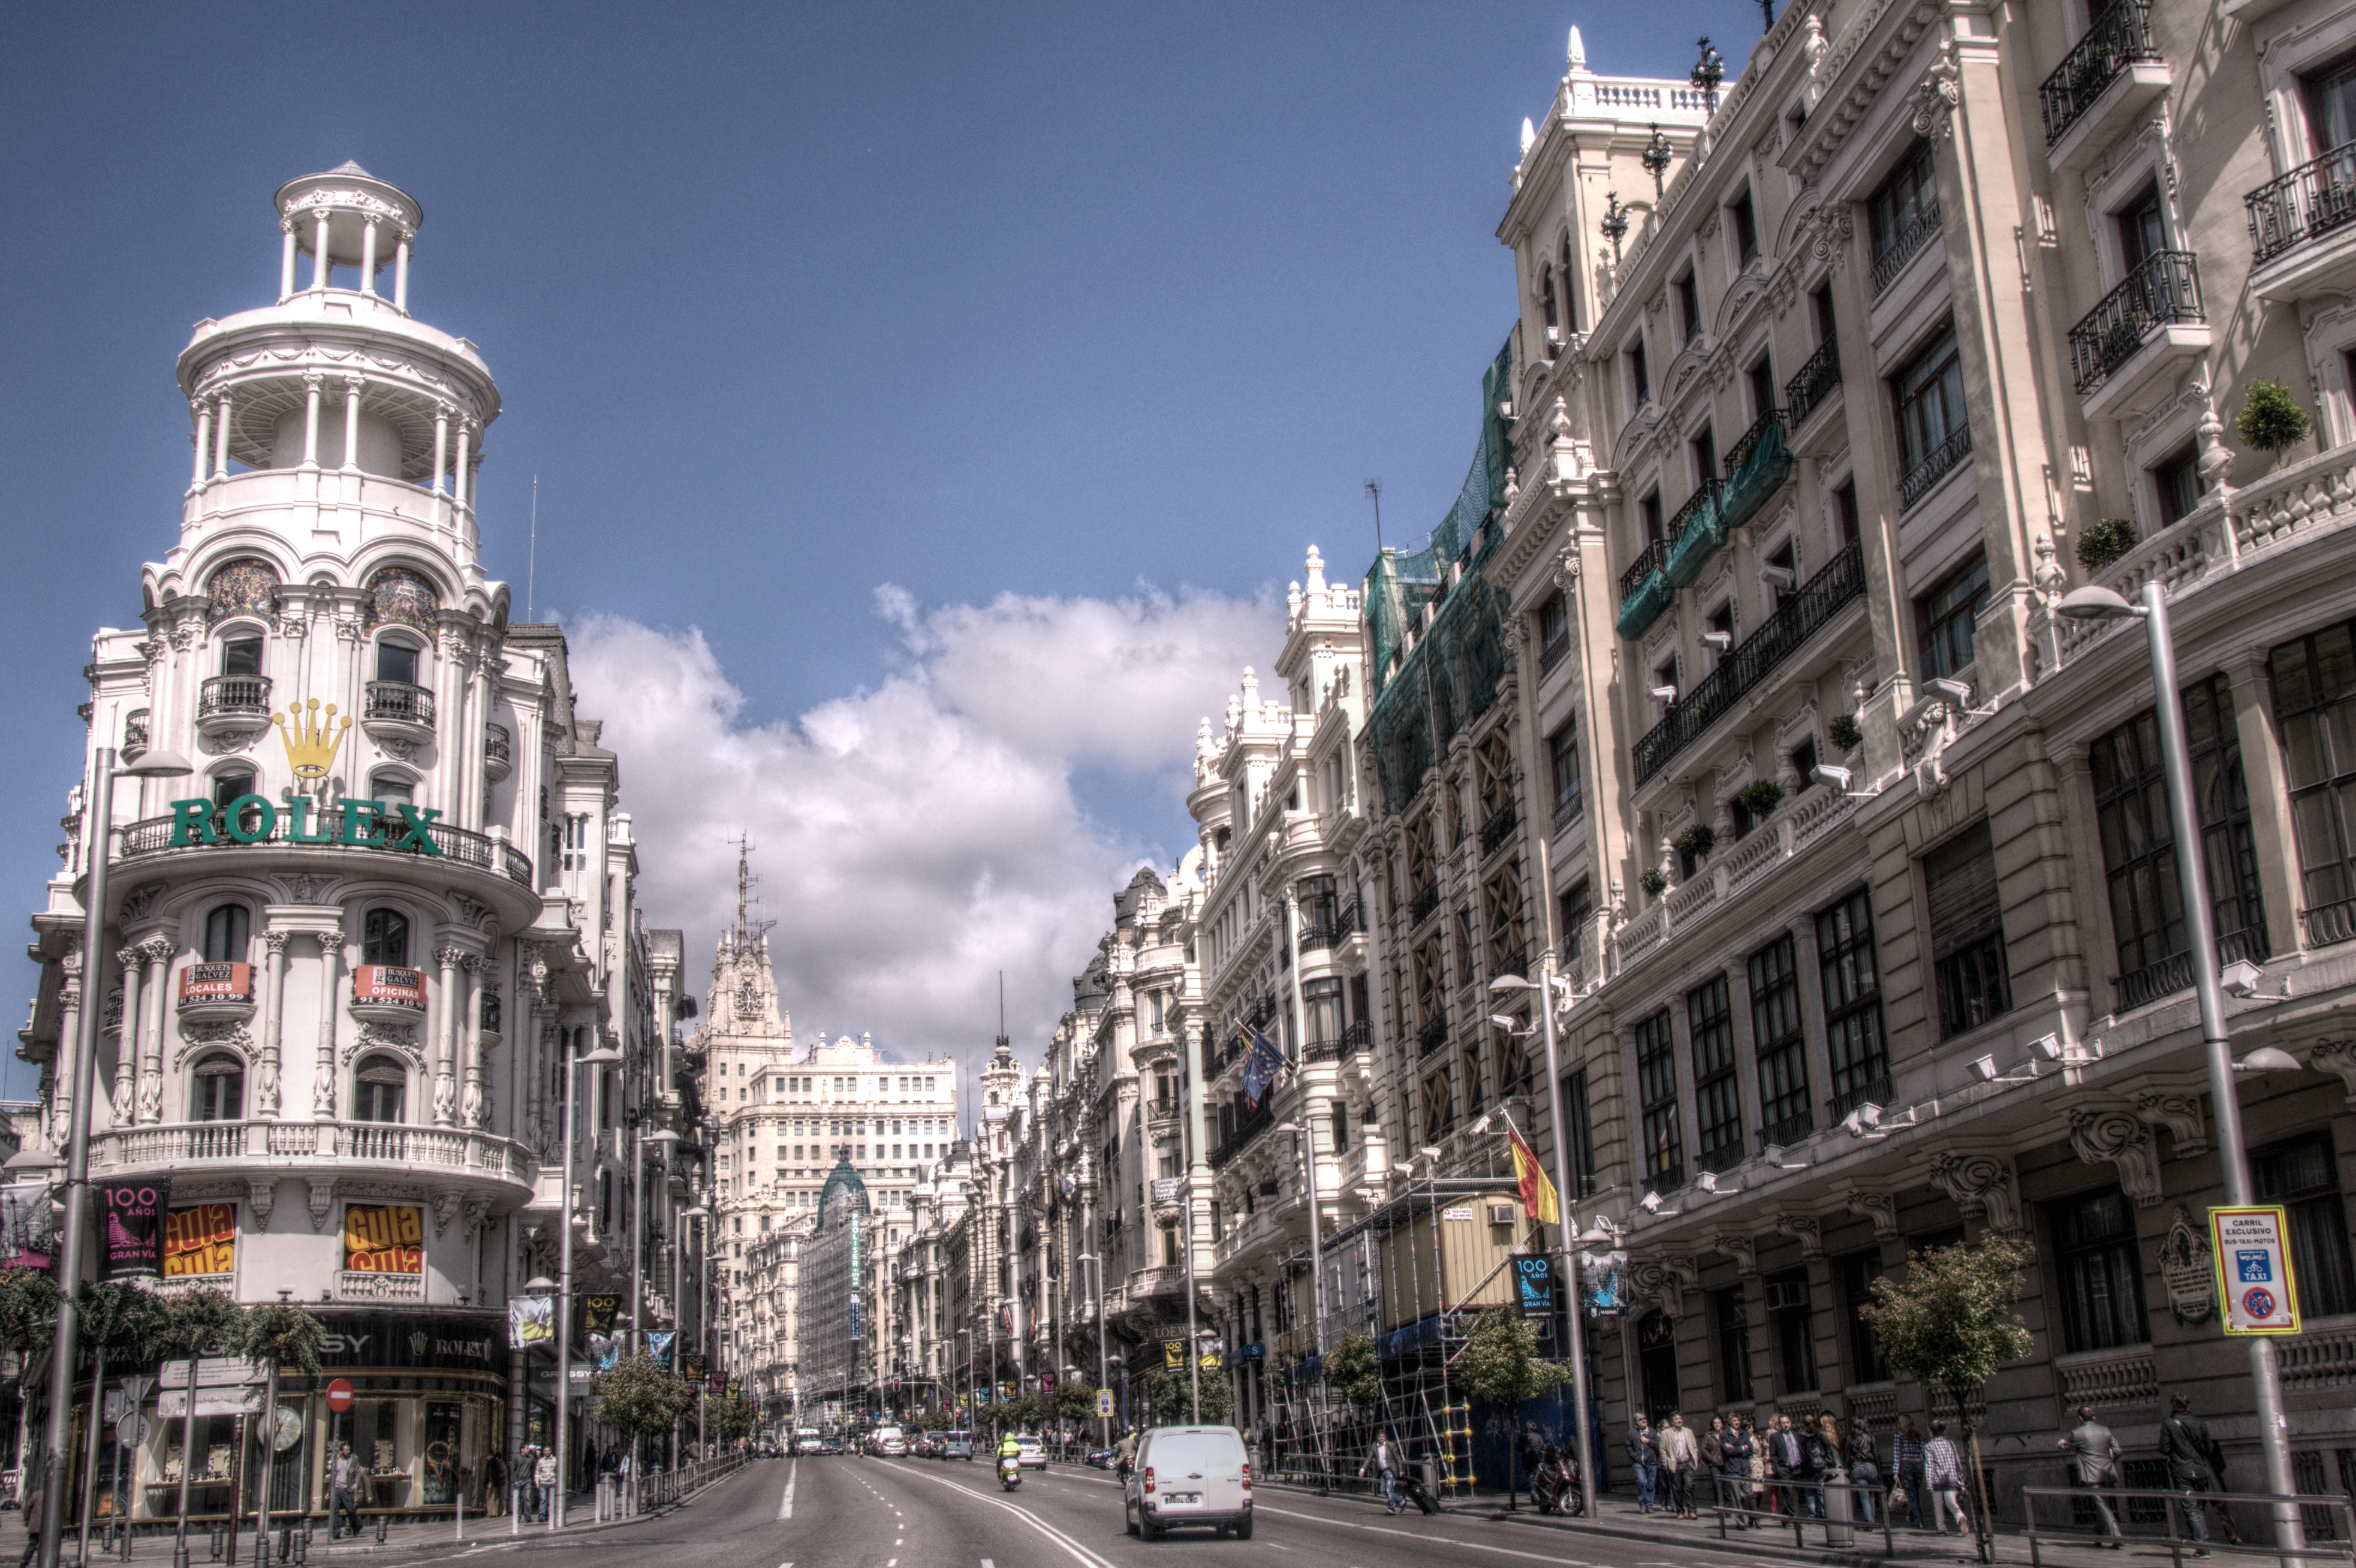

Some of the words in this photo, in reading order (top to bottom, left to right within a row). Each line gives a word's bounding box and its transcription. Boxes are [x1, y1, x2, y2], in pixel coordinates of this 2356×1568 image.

[168, 794, 442, 855] ROLEX
[388, 969, 418, 979] BUSQUETS
[387, 976, 417, 985] GALVEZ
[185, 984, 233, 995] LOCALES
[372, 987, 418, 999] OFICINAS
[105, 1187, 156, 1207] 100
[347, 1205, 422, 1252] Gula
[110, 1250, 140, 1260] GRAN
[141, 1250, 156, 1259] VÍA
[1517, 1259, 1547, 1273] 100
[2244, 1273, 2267, 1281] TAXI
[587, 1298, 615, 1308] 100
[1155, 1325, 1194, 1338] LOEW
[649, 1333, 671, 1343] 100
[435, 1339, 484, 1358] ROLEX
